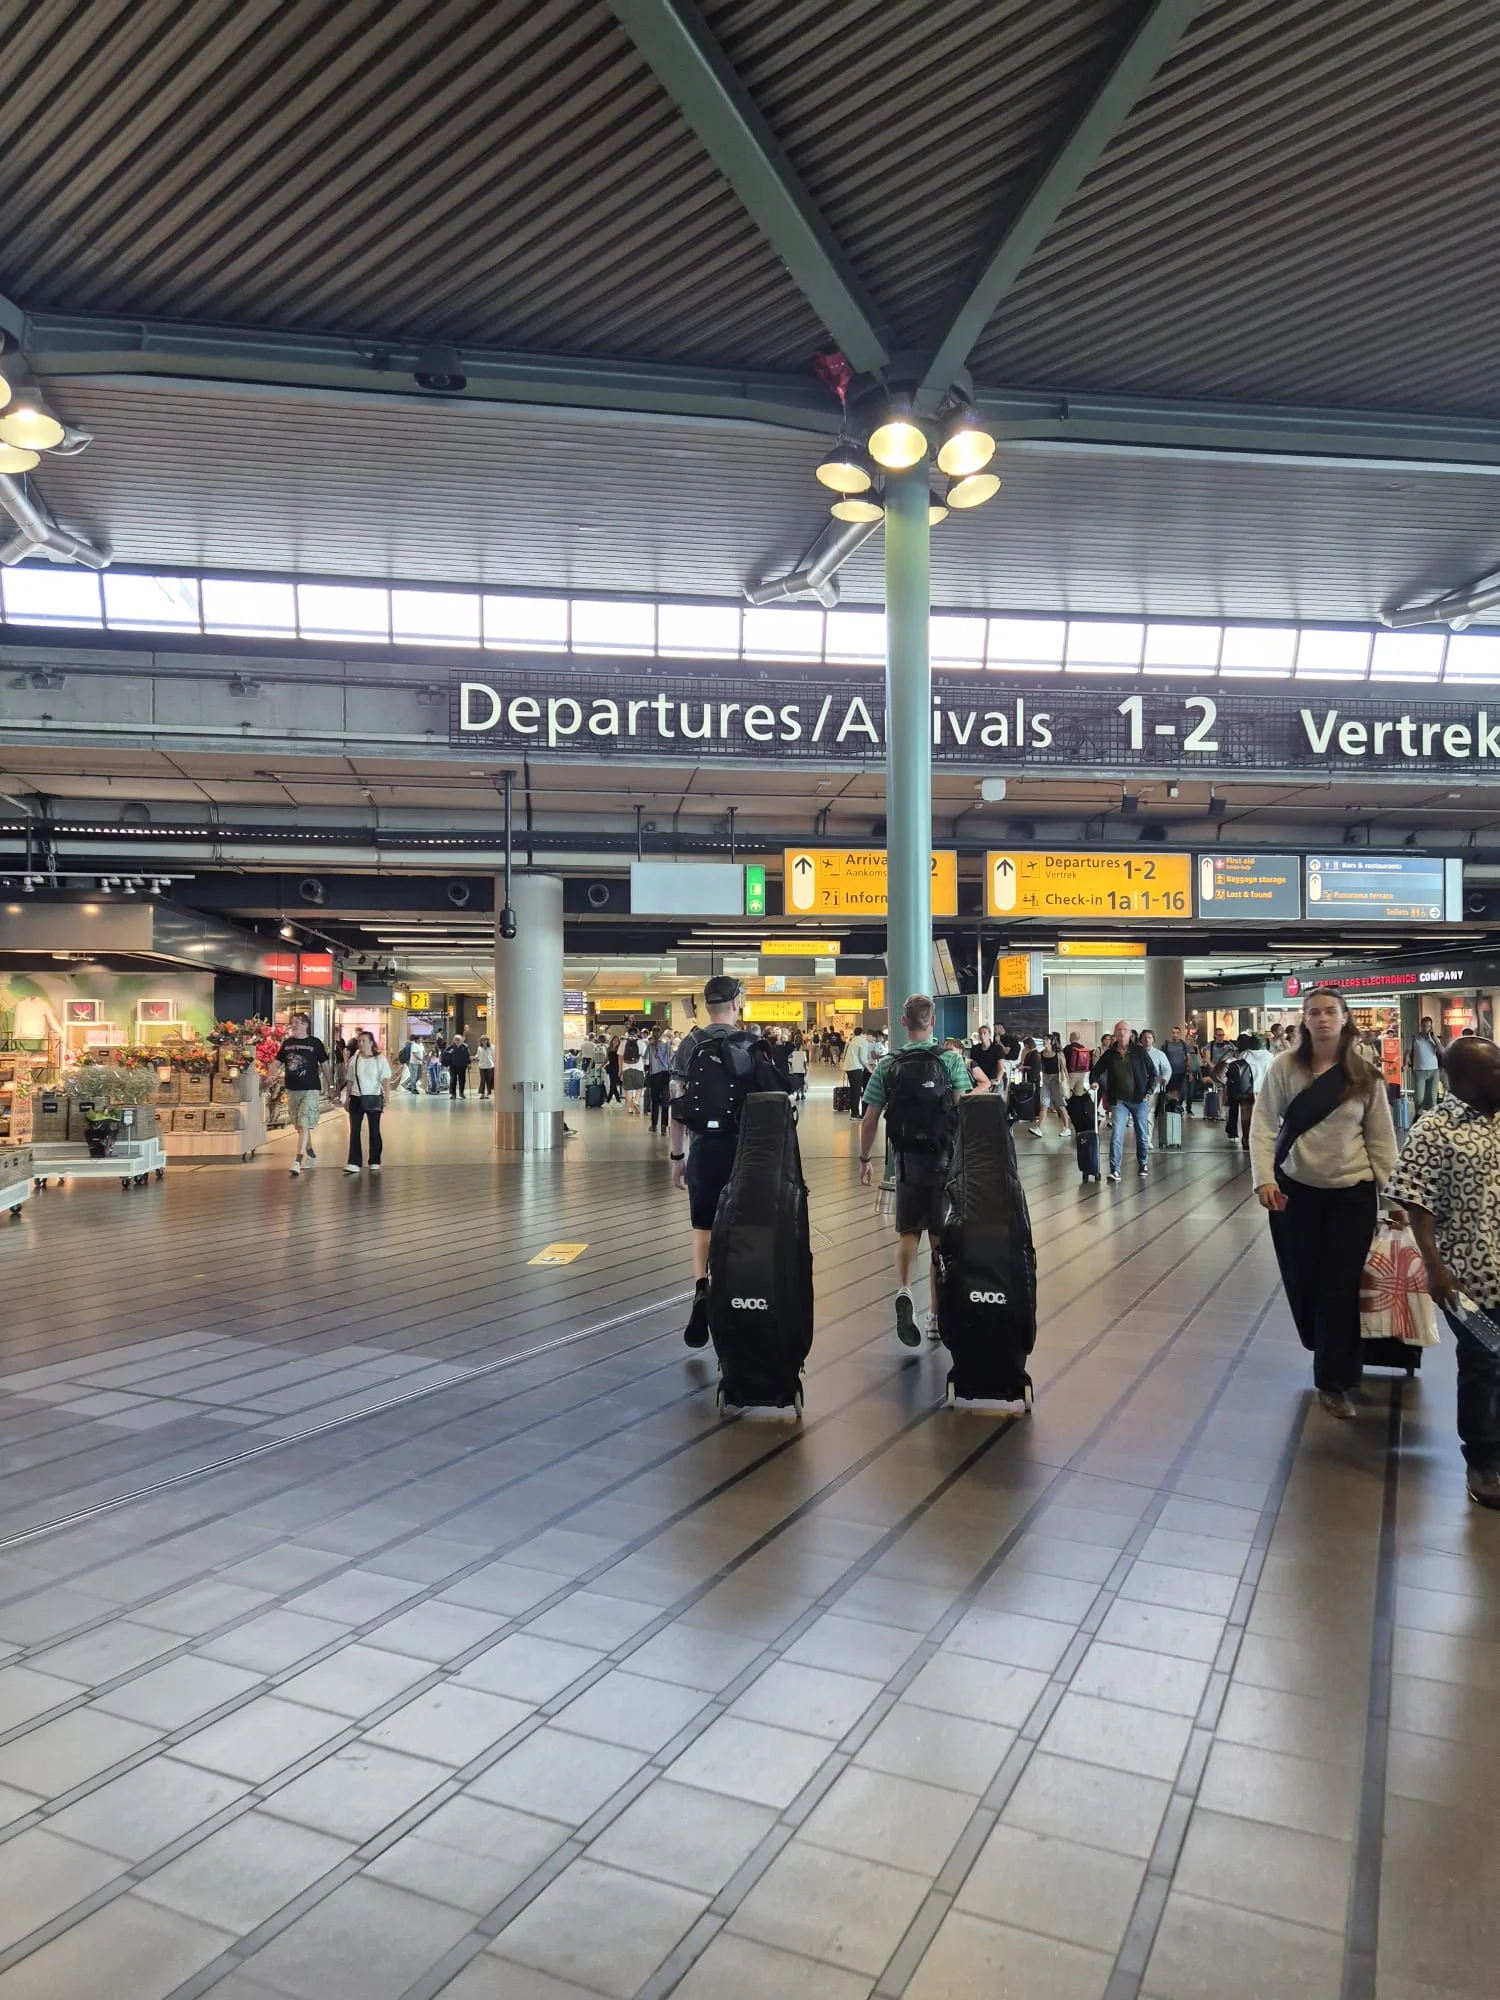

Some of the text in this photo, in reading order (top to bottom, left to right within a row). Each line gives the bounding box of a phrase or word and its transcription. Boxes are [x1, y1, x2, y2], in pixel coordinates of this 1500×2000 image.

[460, 682, 1500, 758] Departures/Aivals 1-2 Vertrek
[845, 853, 887, 866] Arriva
[1045, 856, 1156, 880] Departures 1-2
[1365, 862, 1402, 870] restaurants
[845, 869, 887, 877] Aankoms
[1045, 871, 1076, 879] Vertrek
[1226, 875, 1286, 885] Baggage storage
[1045, 893, 1103, 905] Check-in
[1226, 890, 1242, 898] Lost
[1362, 974, 1417, 986] ELECTRONICS
[1419, 970, 1464, 982] COMPANY
